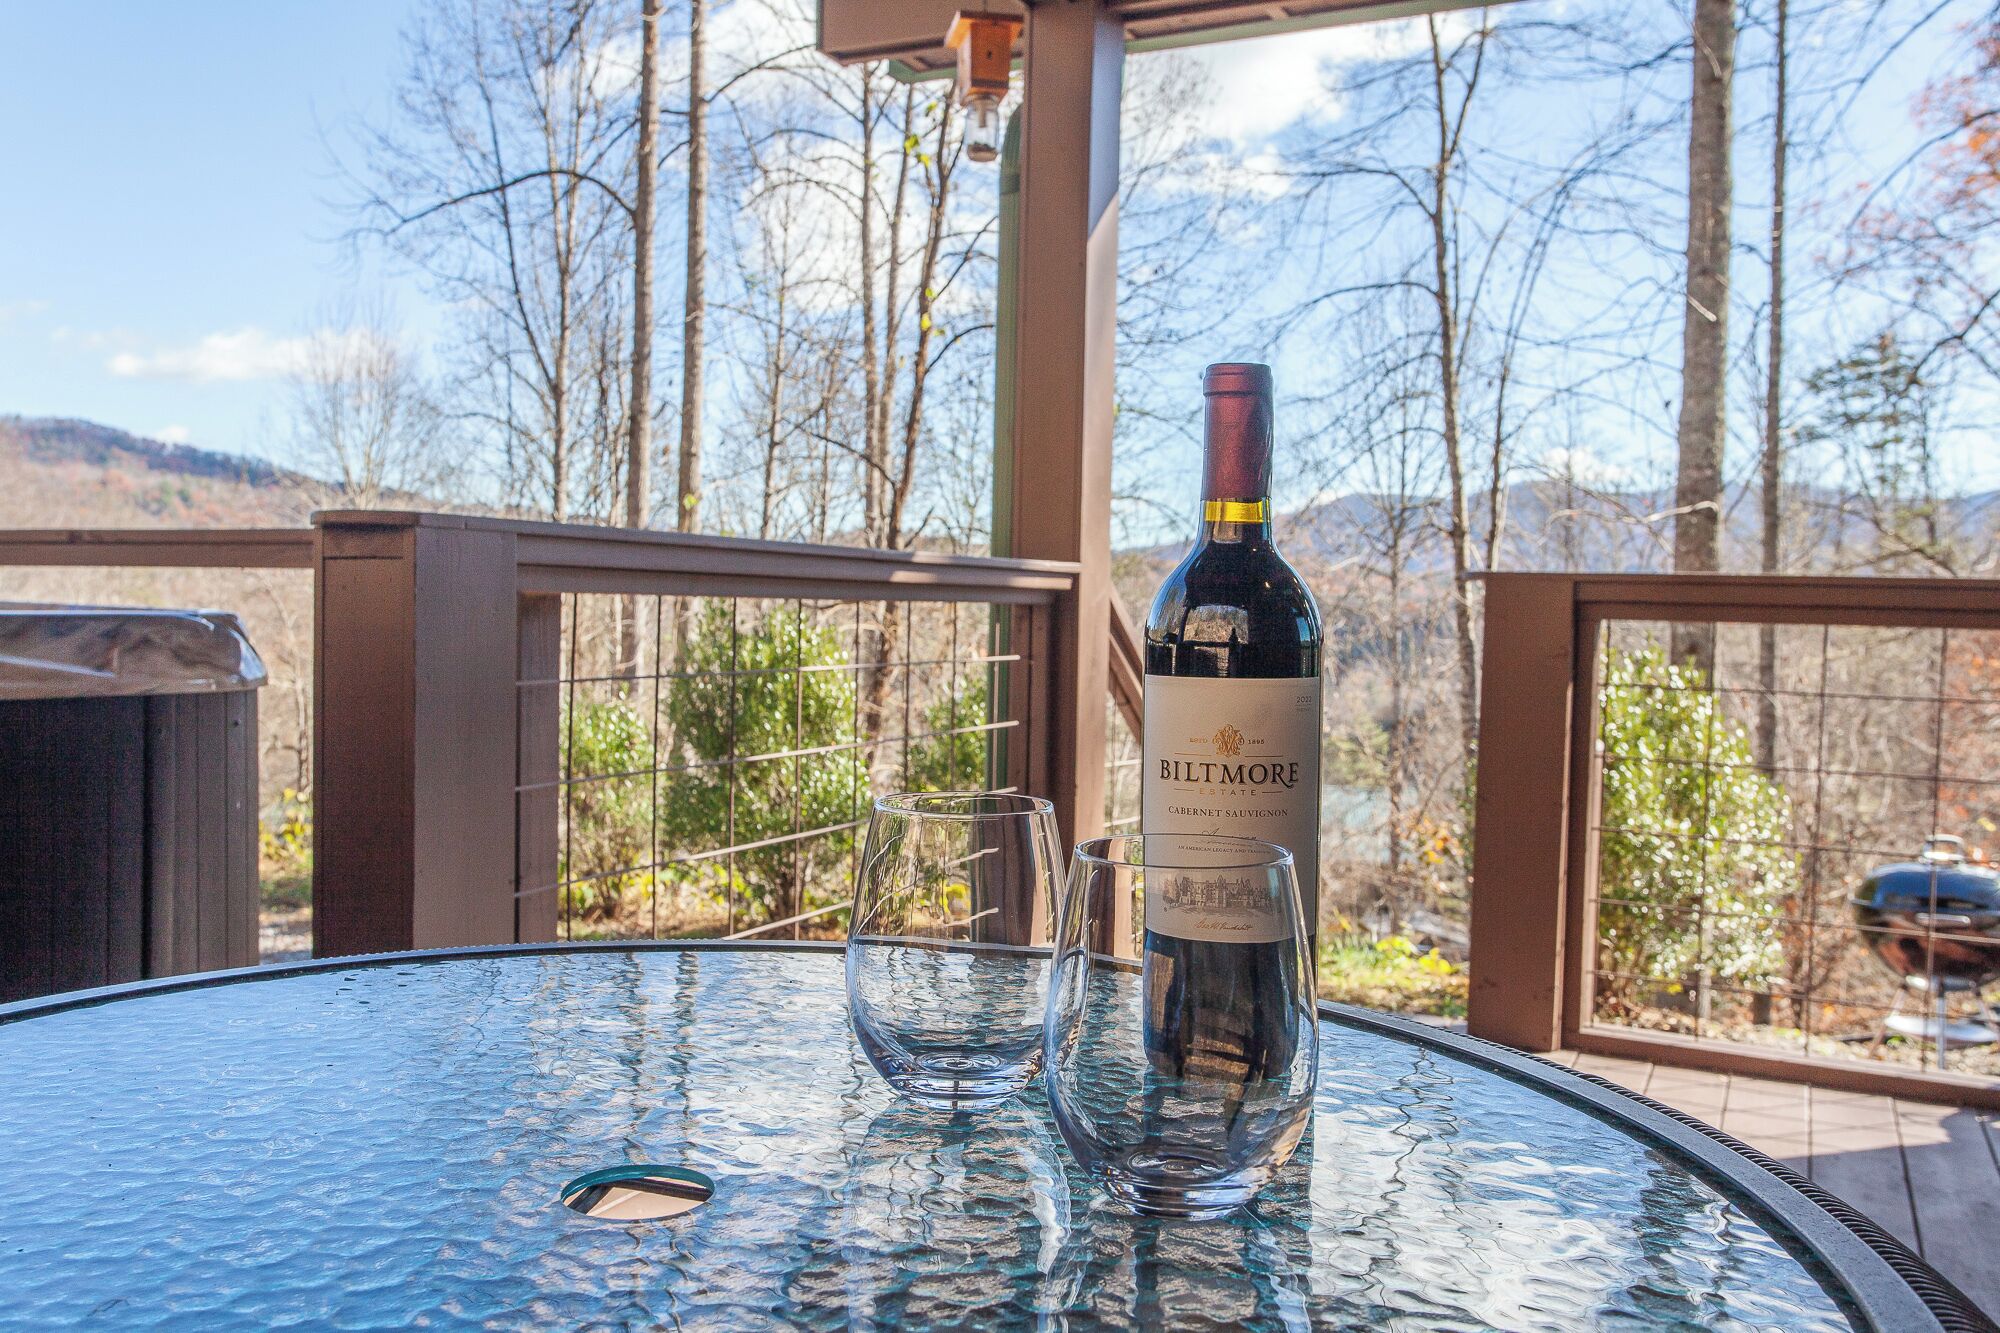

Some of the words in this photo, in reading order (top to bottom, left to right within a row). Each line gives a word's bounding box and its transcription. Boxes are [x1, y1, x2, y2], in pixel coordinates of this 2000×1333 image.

[1160, 758, 1299, 789] BILTMORE
[1199, 787, 1257, 796] ESTATE
[1168, 805, 1223, 818] CABERNET
[1225, 808, 1289, 818] SAUVIGNON
